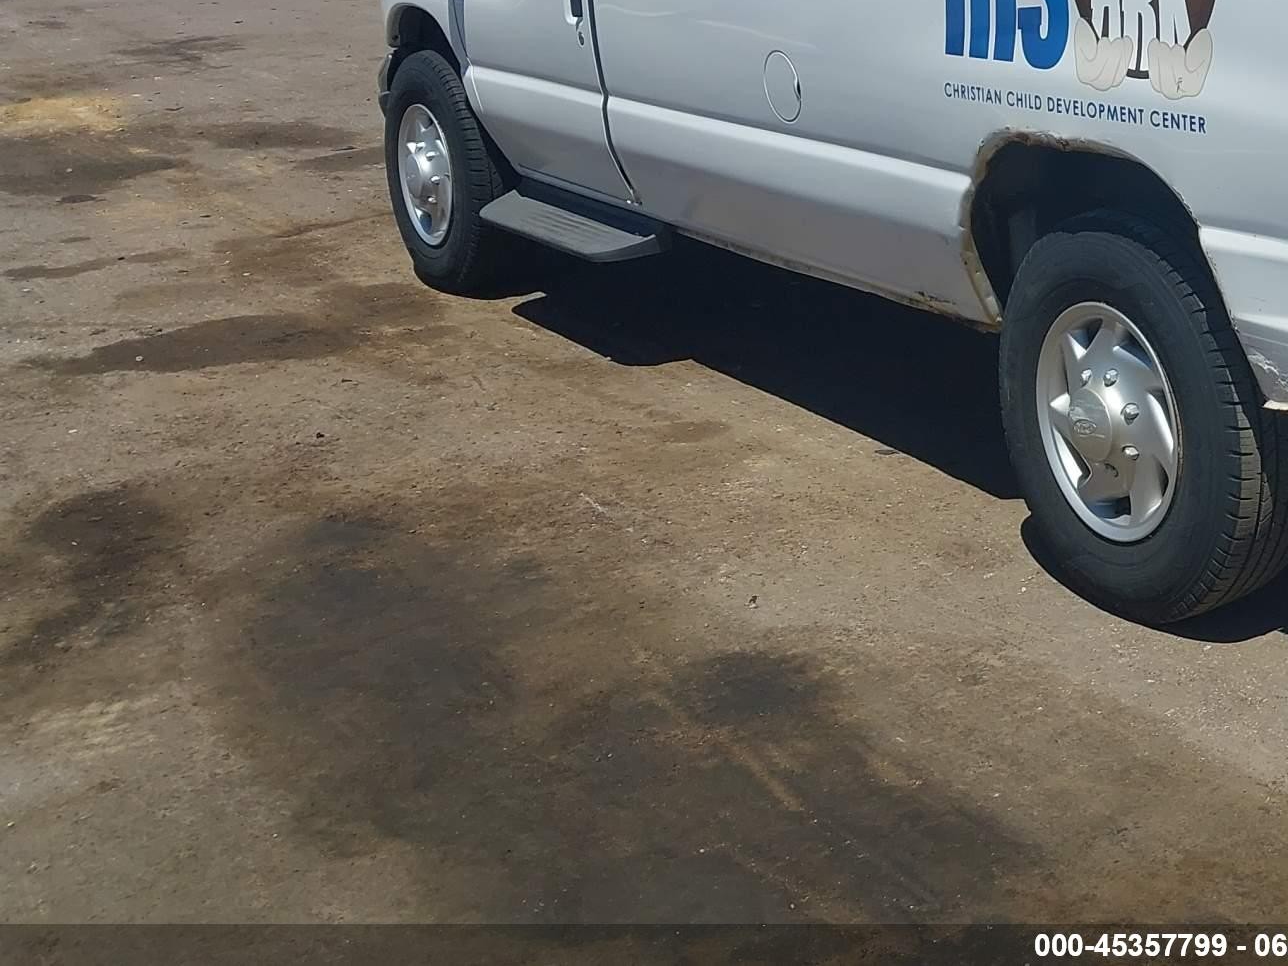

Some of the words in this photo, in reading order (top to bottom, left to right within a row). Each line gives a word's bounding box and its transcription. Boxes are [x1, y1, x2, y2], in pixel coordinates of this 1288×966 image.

[944, 82, 1002, 105] CHRISTIAN
[1006, 91, 1042, 111] CHILD
[1047, 97, 1144, 125] DEVELOPMENT
[1150, 110, 1207, 134] CENTER
